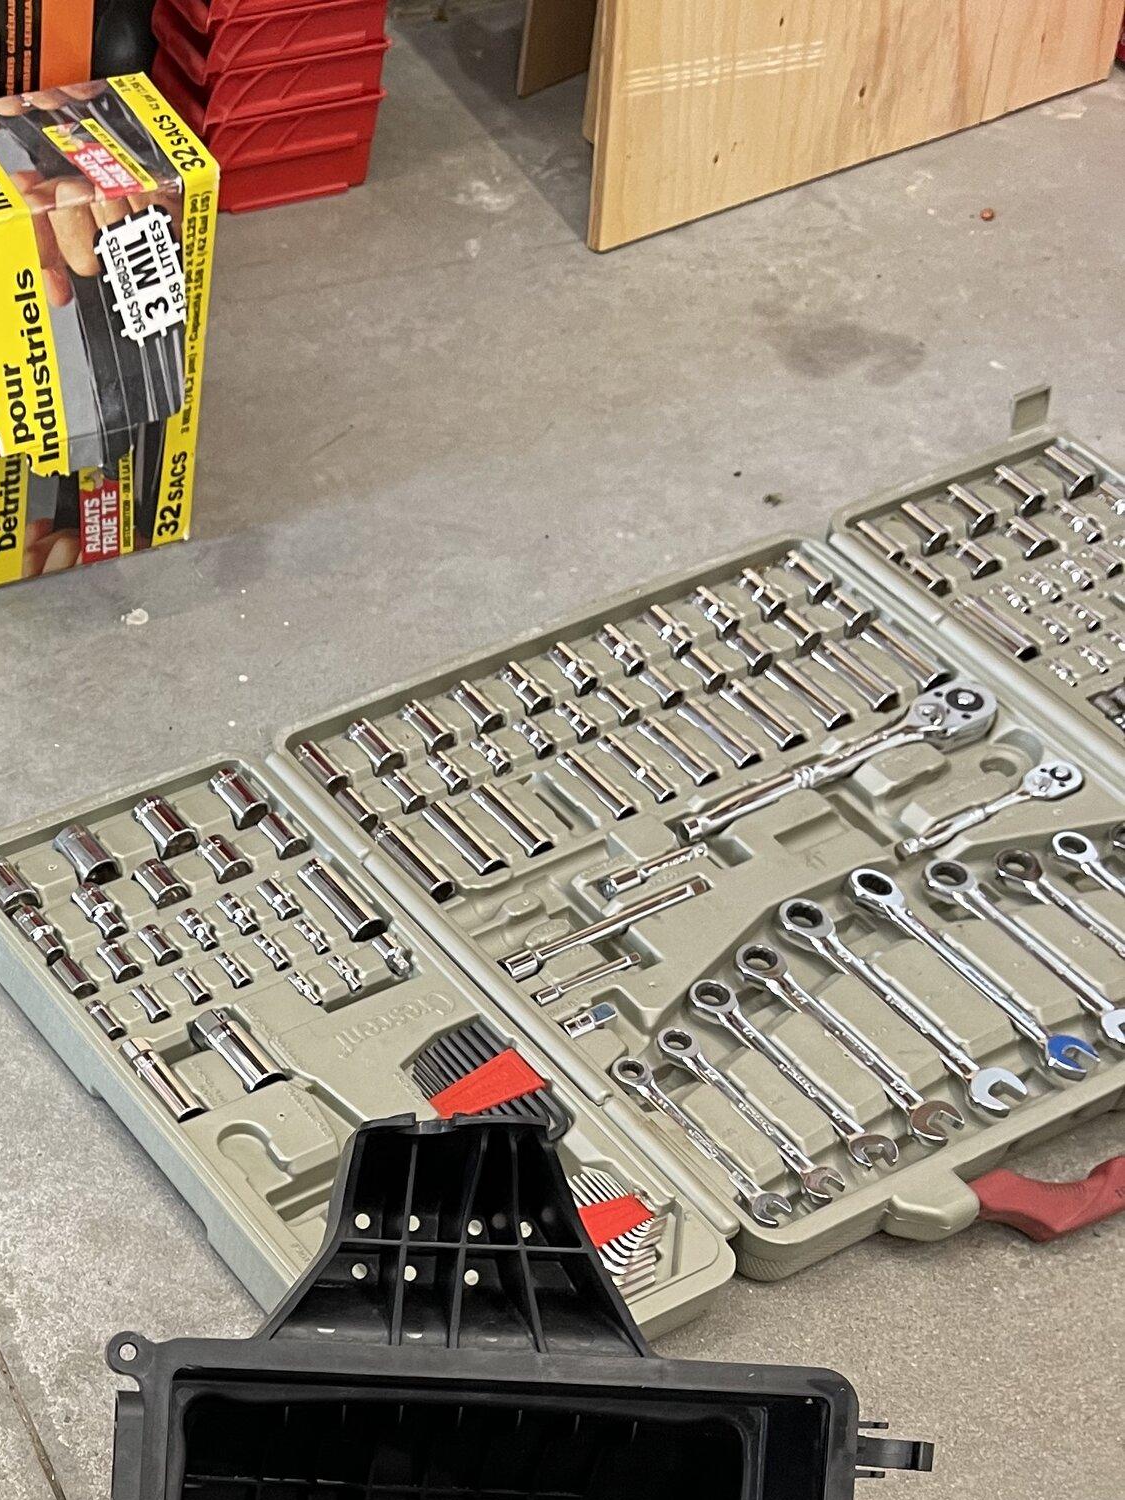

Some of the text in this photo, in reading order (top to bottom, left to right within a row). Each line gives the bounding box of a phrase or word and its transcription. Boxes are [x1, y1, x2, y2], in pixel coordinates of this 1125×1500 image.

[152, 114, 206, 172] 32 SACS
[106, 236, 146, 334] SACS ROBUSTES
[124, 230, 169, 319] 3 MIL
[148, 220, 187, 313] 158 LITRES
[3, 363, 34, 444] pour
[15, 267, 59, 463] Industriels
[83, 497, 101, 554] RABATS
[101, 490, 118, 554] TRUE TIE
[156, 450, 188, 537] 32 SACS
